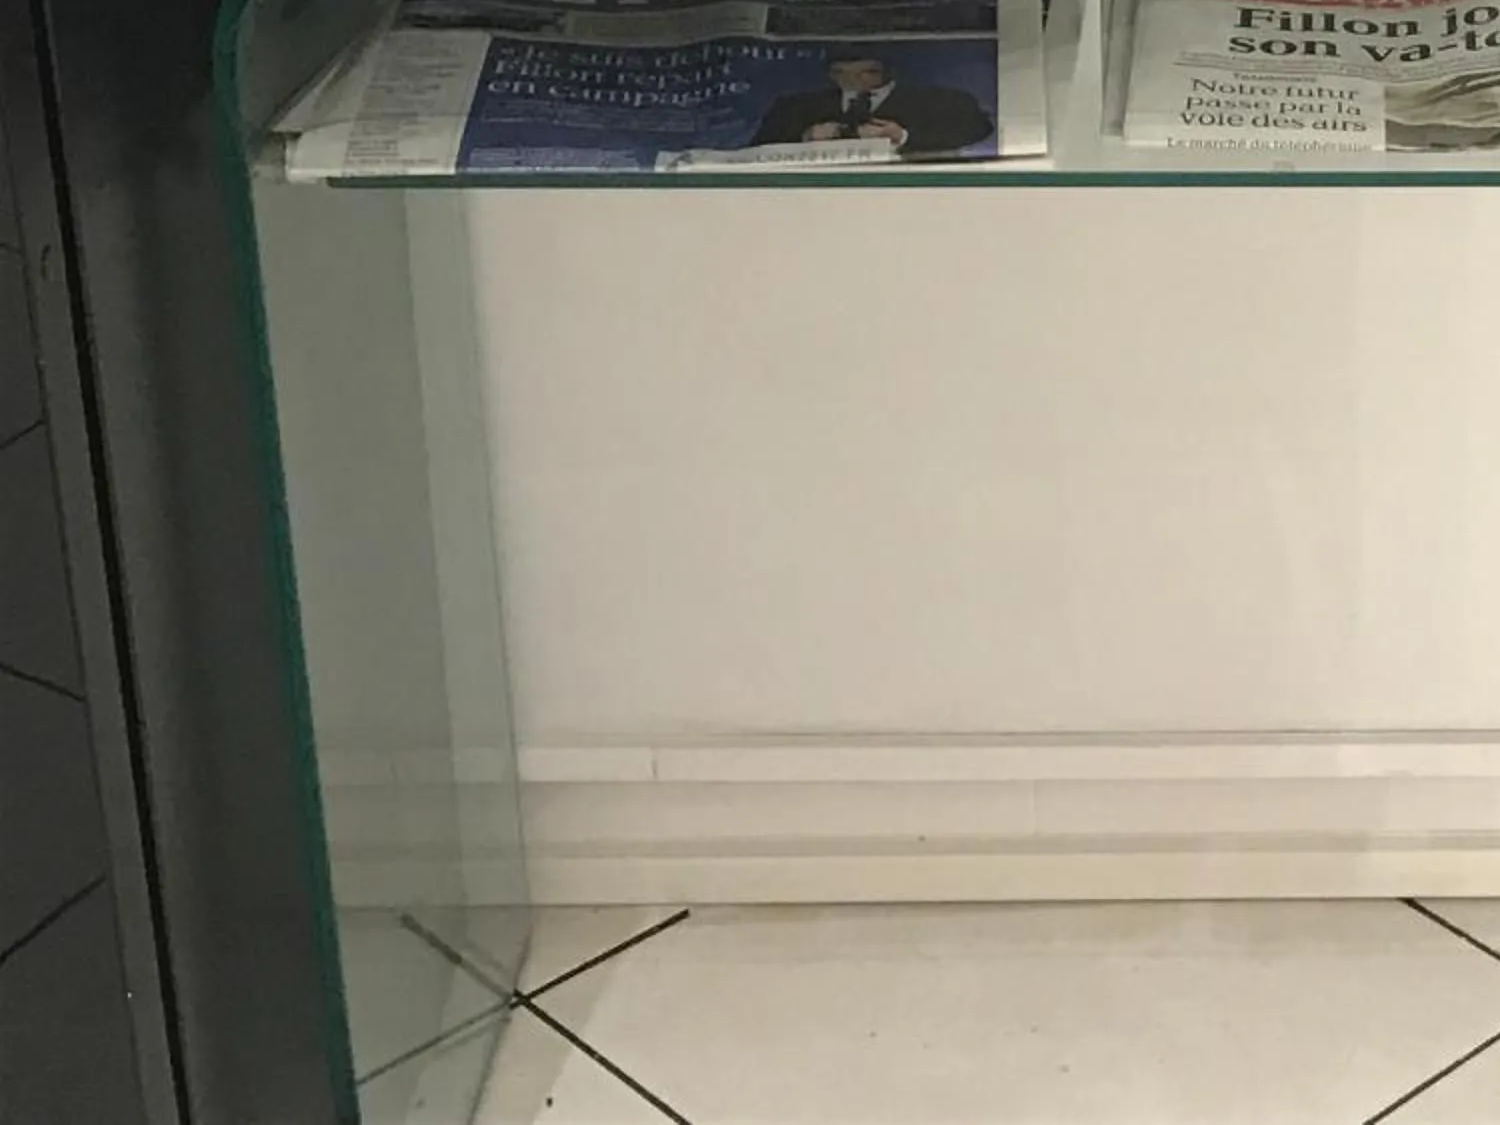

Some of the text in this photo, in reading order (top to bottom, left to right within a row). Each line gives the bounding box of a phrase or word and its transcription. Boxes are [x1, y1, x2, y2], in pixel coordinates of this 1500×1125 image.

[1233, 6, 1421, 39] Fillon
[1229, 36, 1341, 58] son
[1192, 78, 1361, 101] Notre futur
[1186, 95, 1363, 116] passe par la
[1180, 111, 1369, 133] voie des airs
